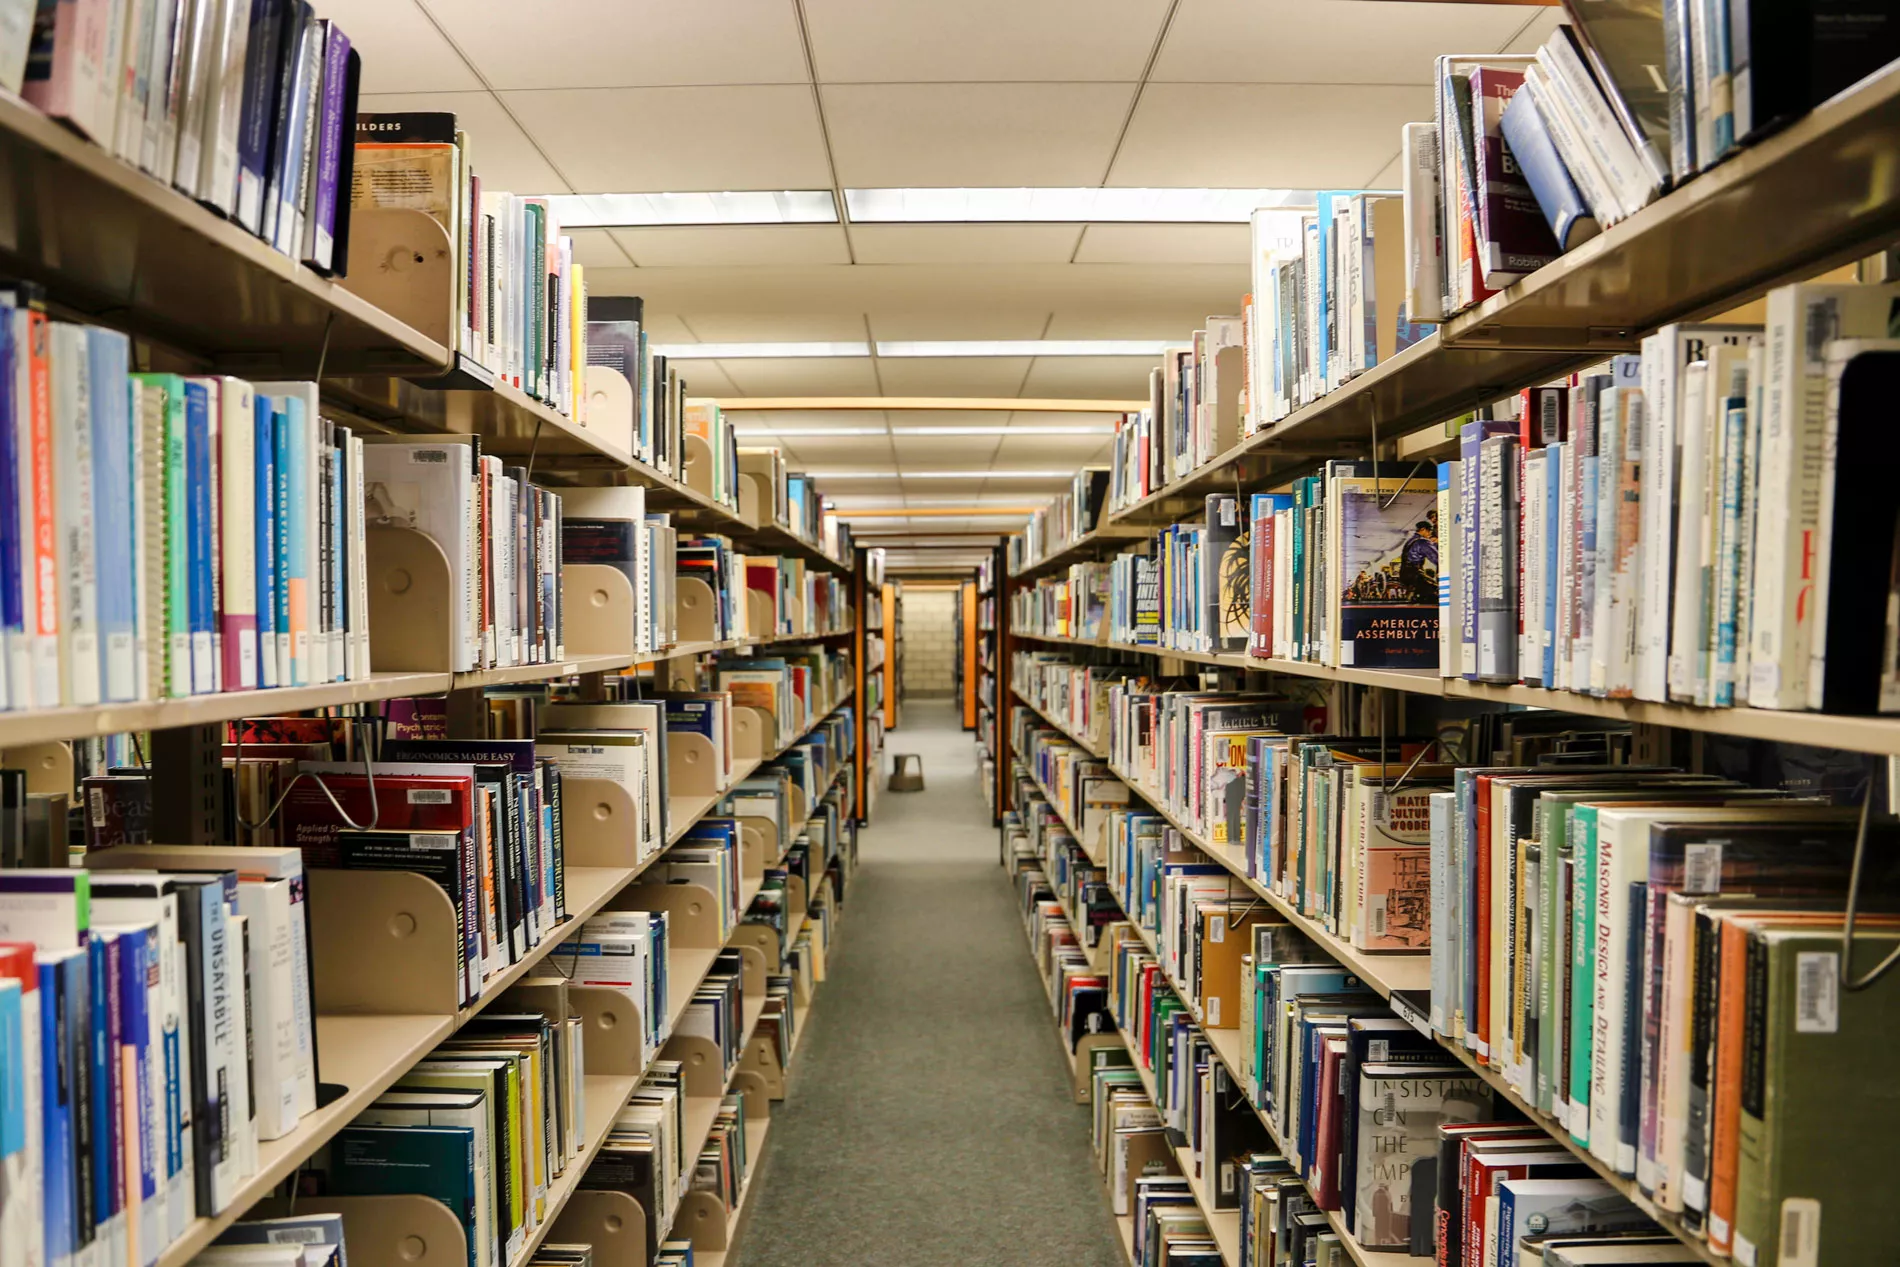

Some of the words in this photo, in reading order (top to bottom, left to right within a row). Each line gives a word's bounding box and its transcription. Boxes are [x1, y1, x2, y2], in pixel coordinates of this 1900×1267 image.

[1508, 255, 1542, 267] Robin
[279, 472, 289, 555] TARGETING
[1465, 455, 1477, 530] Building
[281, 560, 291, 617] AUTISM
[1464, 531, 1477, 639] Engineering
[1355, 629, 1418, 640] ASSEMBLY
[1424, 629, 1440, 640] LI
[1370, 618, 1440, 630] AMERICA'S
[396, 752, 459, 762] ERGONOMICS
[461, 752, 489, 762] MADE
[491, 752, 517, 762] EASY
[296, 823, 328, 833] Applied
[296, 833, 332, 843] Strength
[512, 796, 521, 864] Nanoscale
[1576, 820, 1588, 880] MEANS
[554, 857, 564, 907] DREAMS
[1357, 860, 1365, 909] CULTURE
[1576, 881, 1587, 921] UNIT
[1599, 839, 1613, 920] MASONRY
[1575, 921, 1586, 967] PRICE
[1598, 923, 1611, 981] DESIGN
[1645, 887, 1657, 1015] BRICKWORK
[211, 929, 226, 1047] UNSAYABLE
[1540, 960, 1549, 1017] ESTIMATING
[1597, 984, 1606, 1010] AND
[1595, 1014, 1609, 1096] DETAILING
[1373, 1080, 1491, 1098] INSISTING
[1372, 1135, 1408, 1154] THE
[1373, 1163, 1409, 1181] IMP
[1439, 1209, 1451, 1258] Concepts
[1504, 1206, 1512, 1255] Engineering
